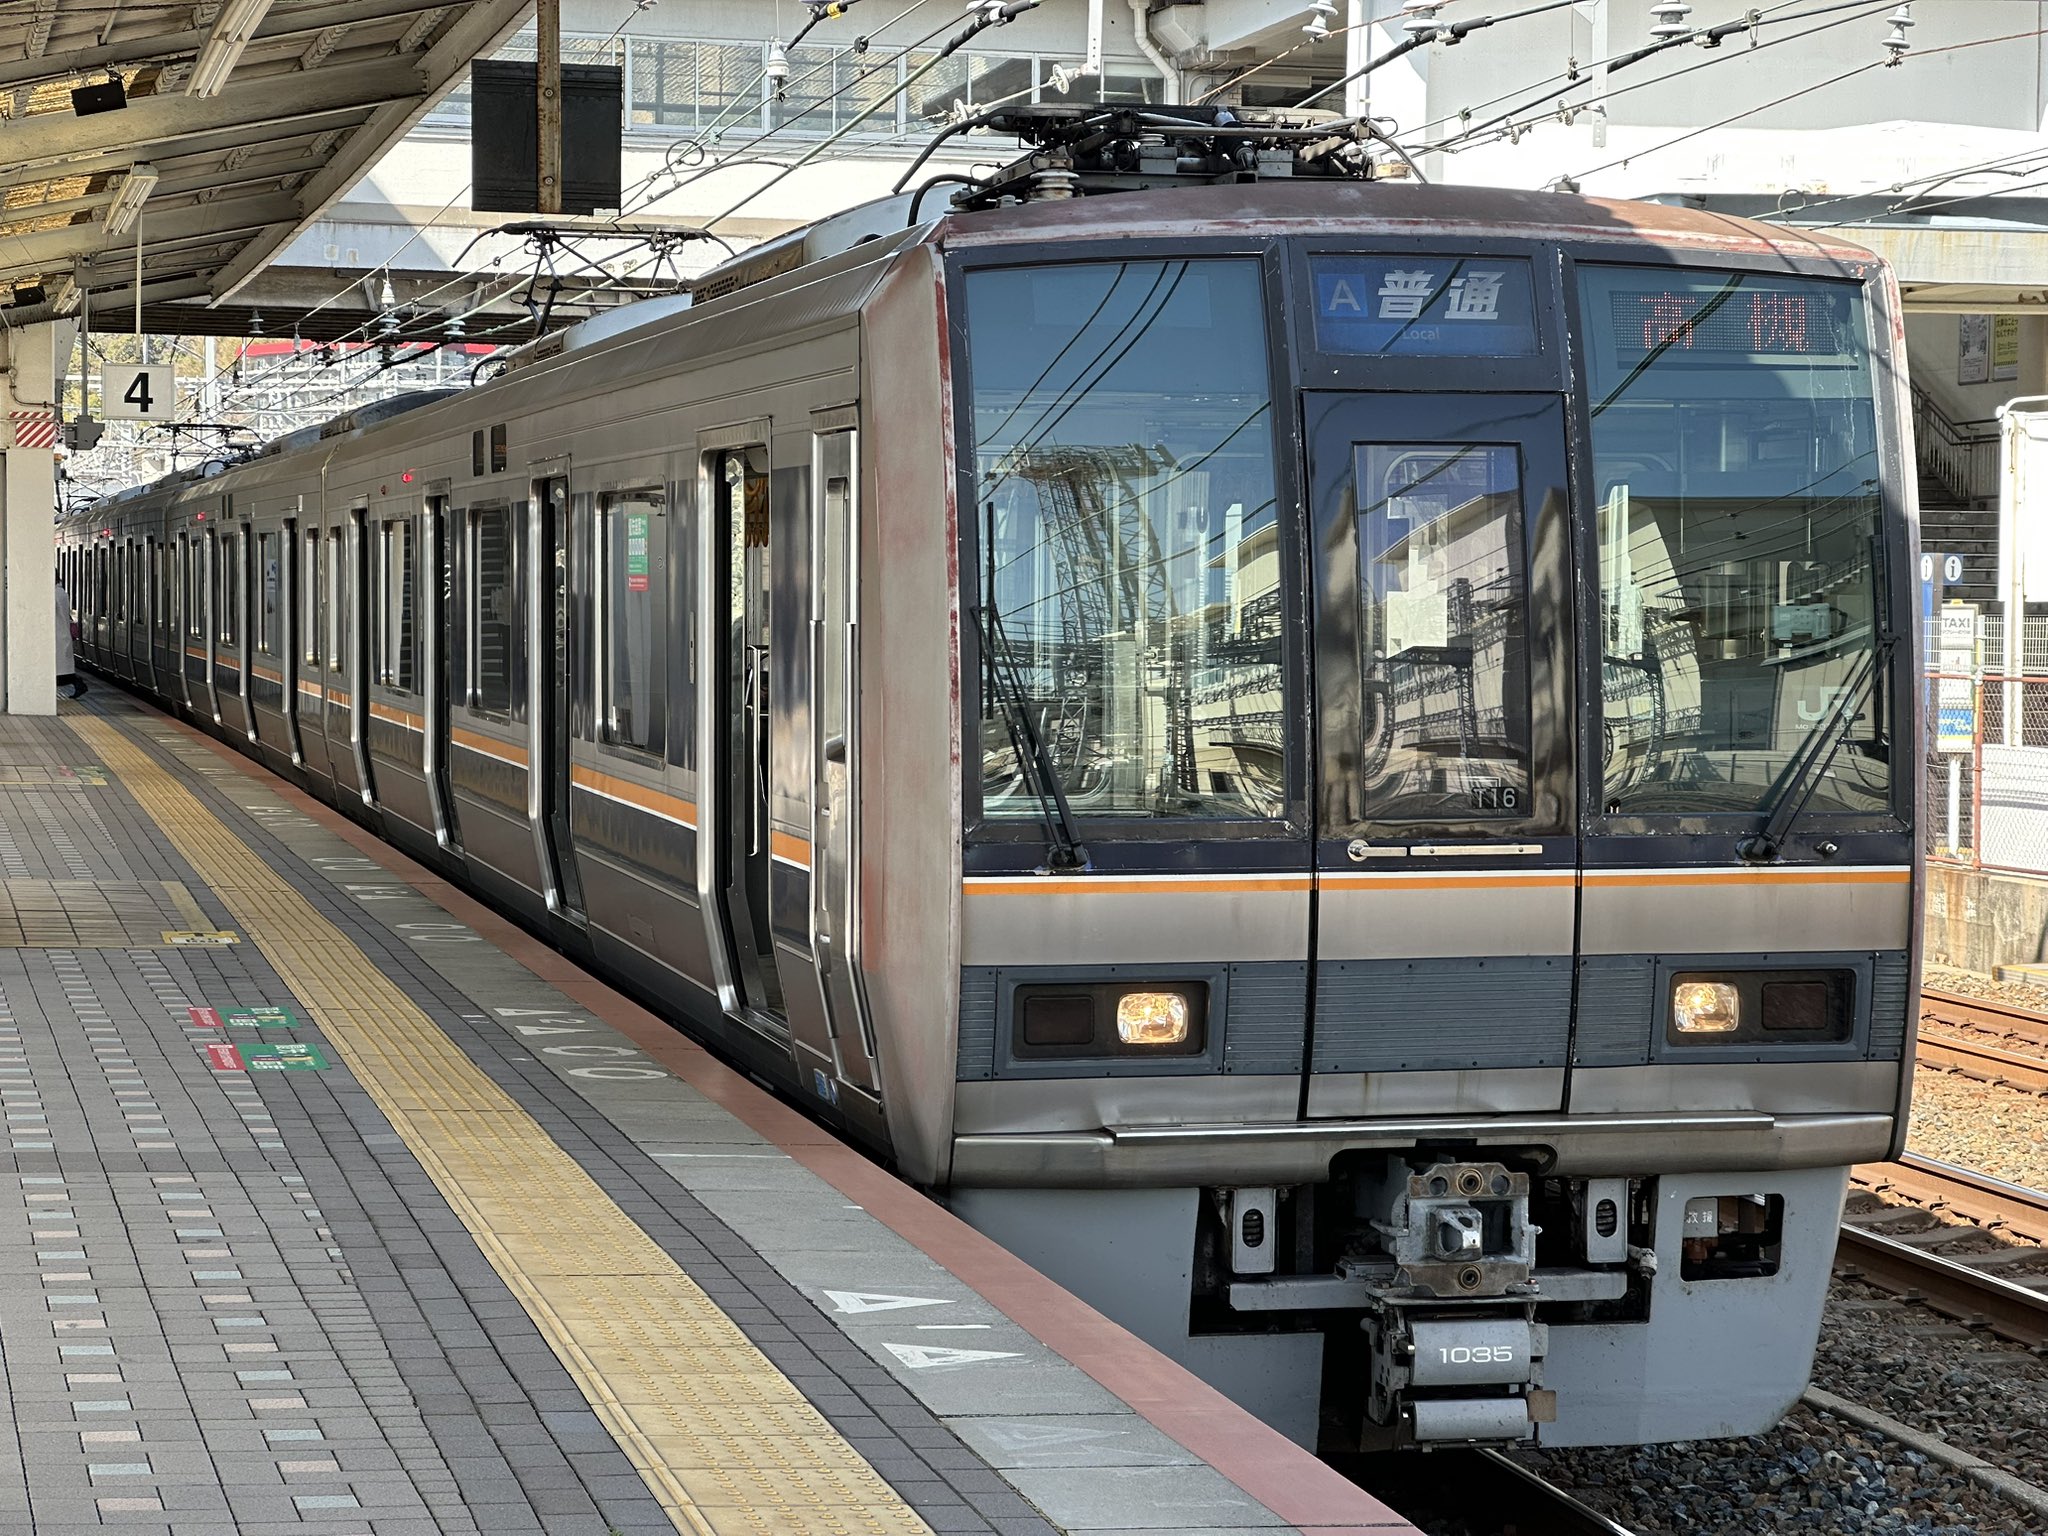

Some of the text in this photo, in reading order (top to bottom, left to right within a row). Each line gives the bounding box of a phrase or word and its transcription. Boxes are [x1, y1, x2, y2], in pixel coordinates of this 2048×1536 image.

[1328, 269, 1505, 320] A 普通
[1640, 292, 1809, 351] 高槻
[1403, 327, 1440, 341] Local
[124, 372, 153, 412] 4
[1942, 617, 1970, 628] TAXI
[1473, 787, 1515, 808] T16
[1439, 1346, 1513, 1363] 1035
